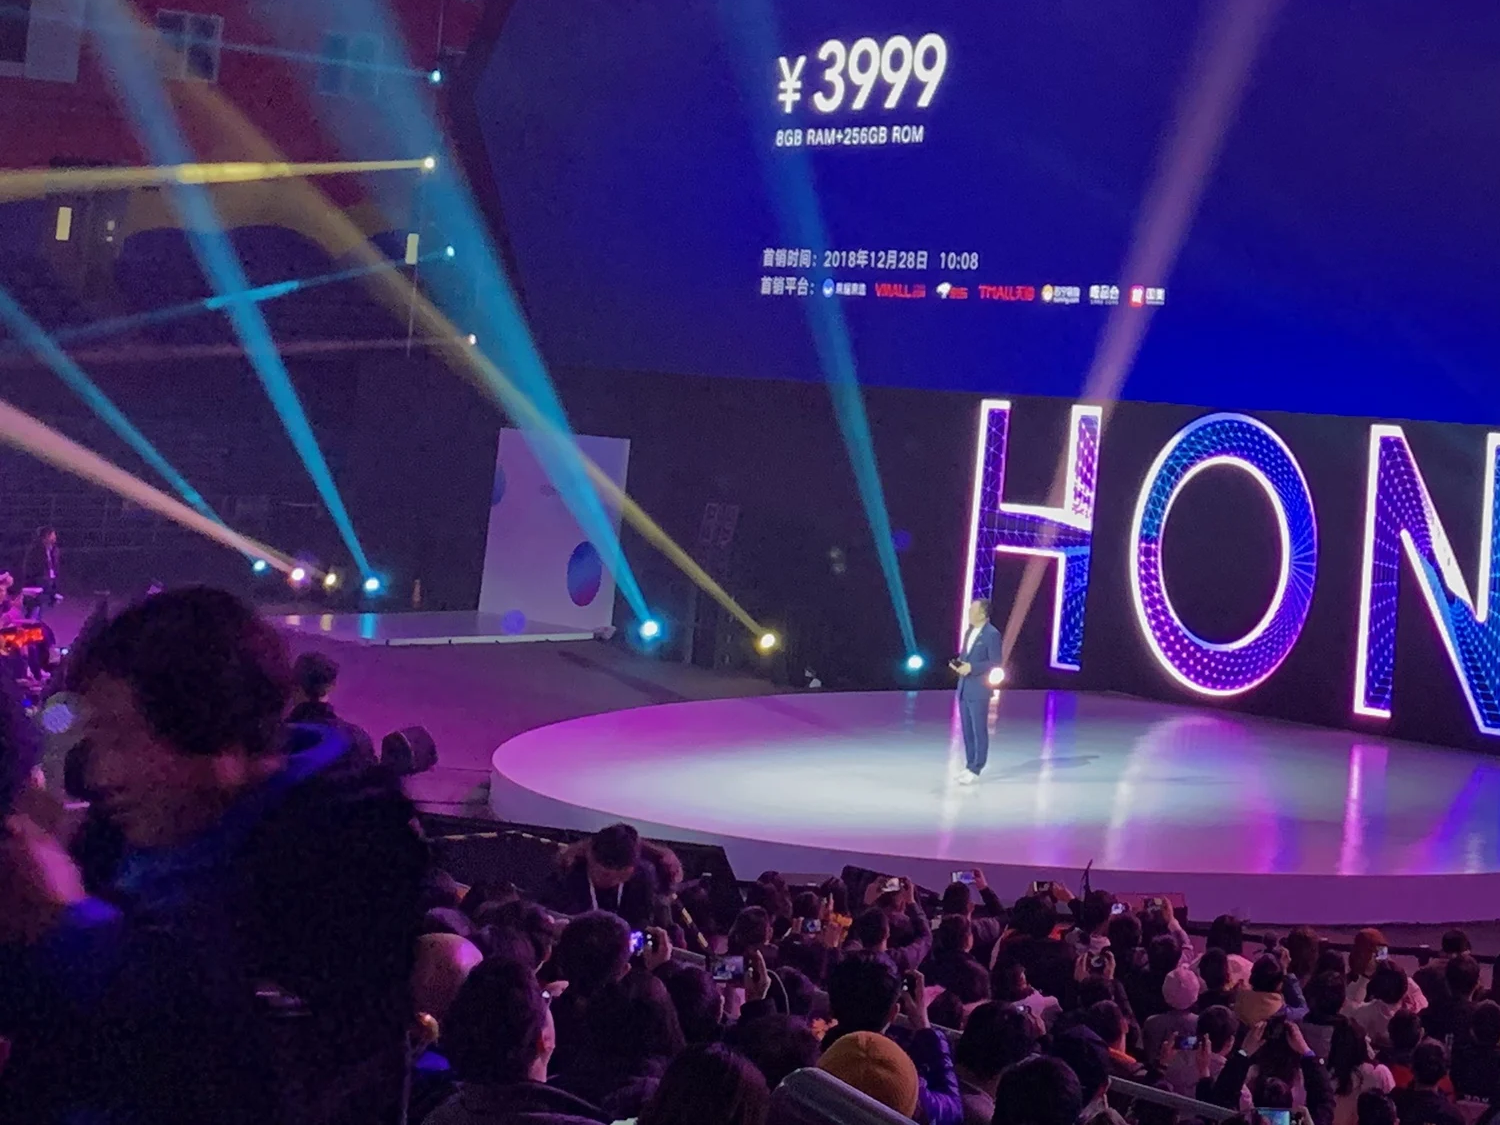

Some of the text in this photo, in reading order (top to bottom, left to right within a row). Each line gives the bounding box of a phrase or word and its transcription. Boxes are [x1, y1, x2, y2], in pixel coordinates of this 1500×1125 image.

[775, 125, 925, 147] 8GB RAM+256GB ROM
[940, 251, 979, 270] 10:08
